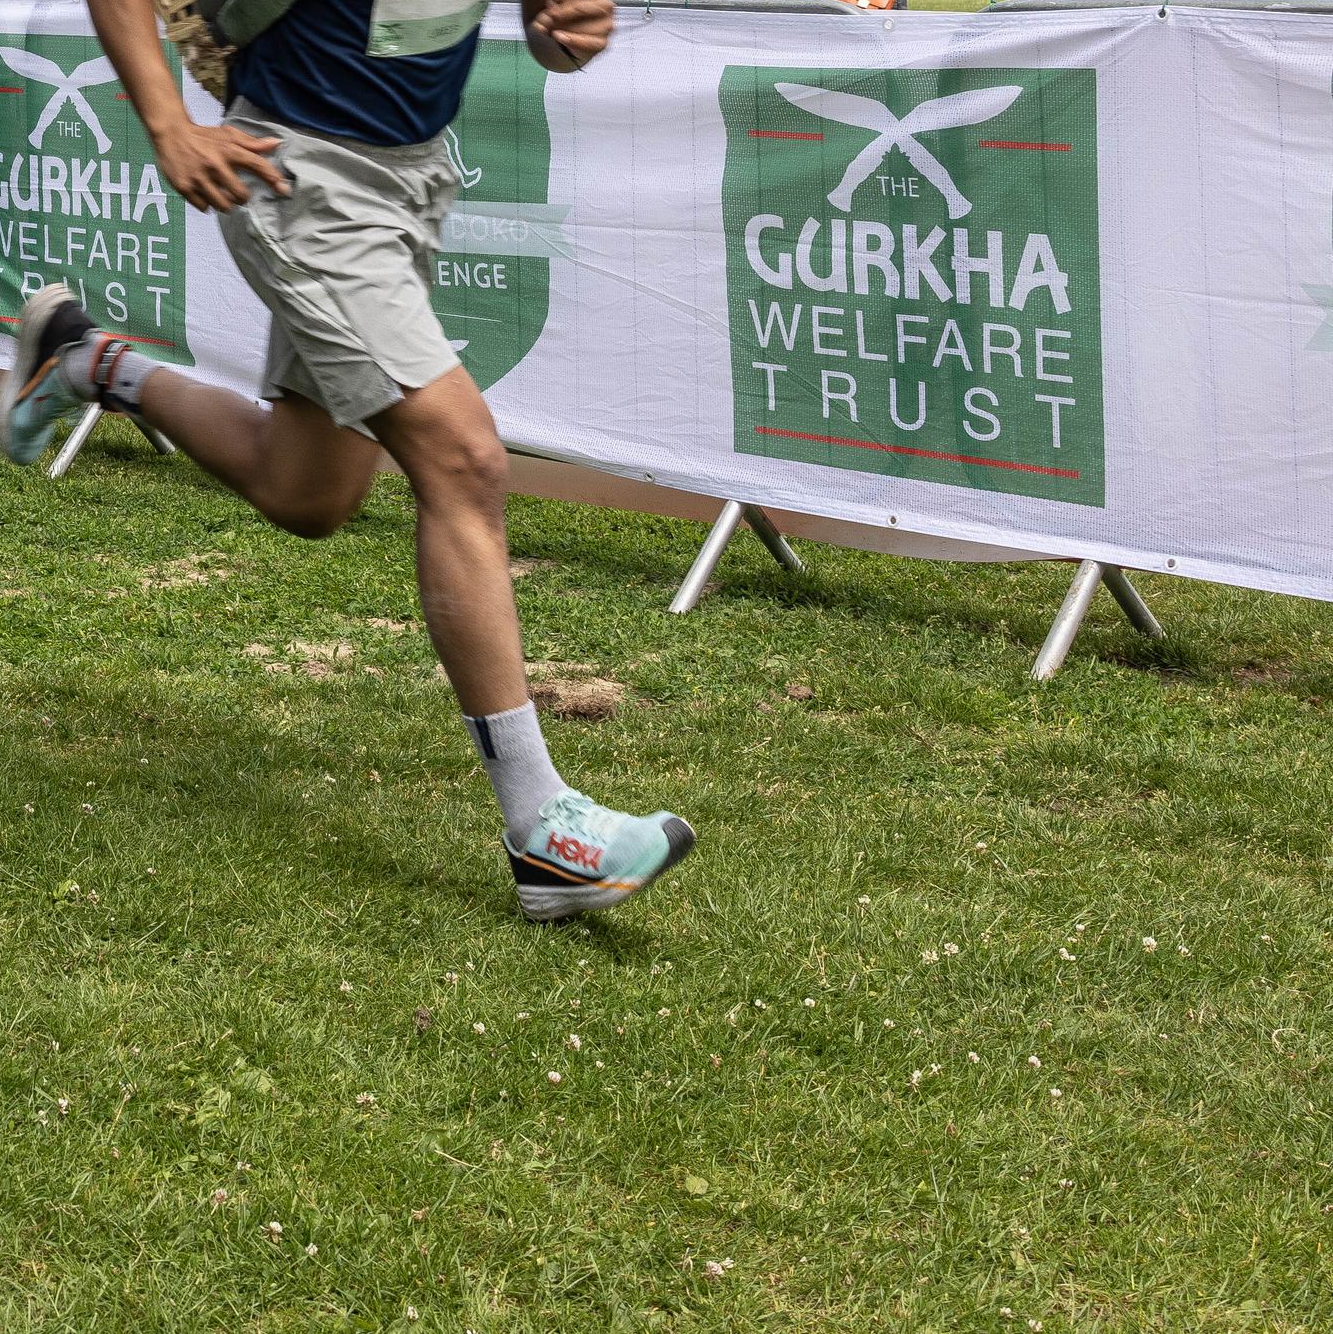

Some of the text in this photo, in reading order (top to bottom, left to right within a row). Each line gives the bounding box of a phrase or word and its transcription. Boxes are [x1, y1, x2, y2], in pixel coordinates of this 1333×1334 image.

[56, 121, 82, 139] THE
[876, 174, 920, 198] THE
[743, 213, 1071, 315] GURKHA
[747, 299, 1073, 384] WELFARE
[751, 361, 1077, 449] TRUST
